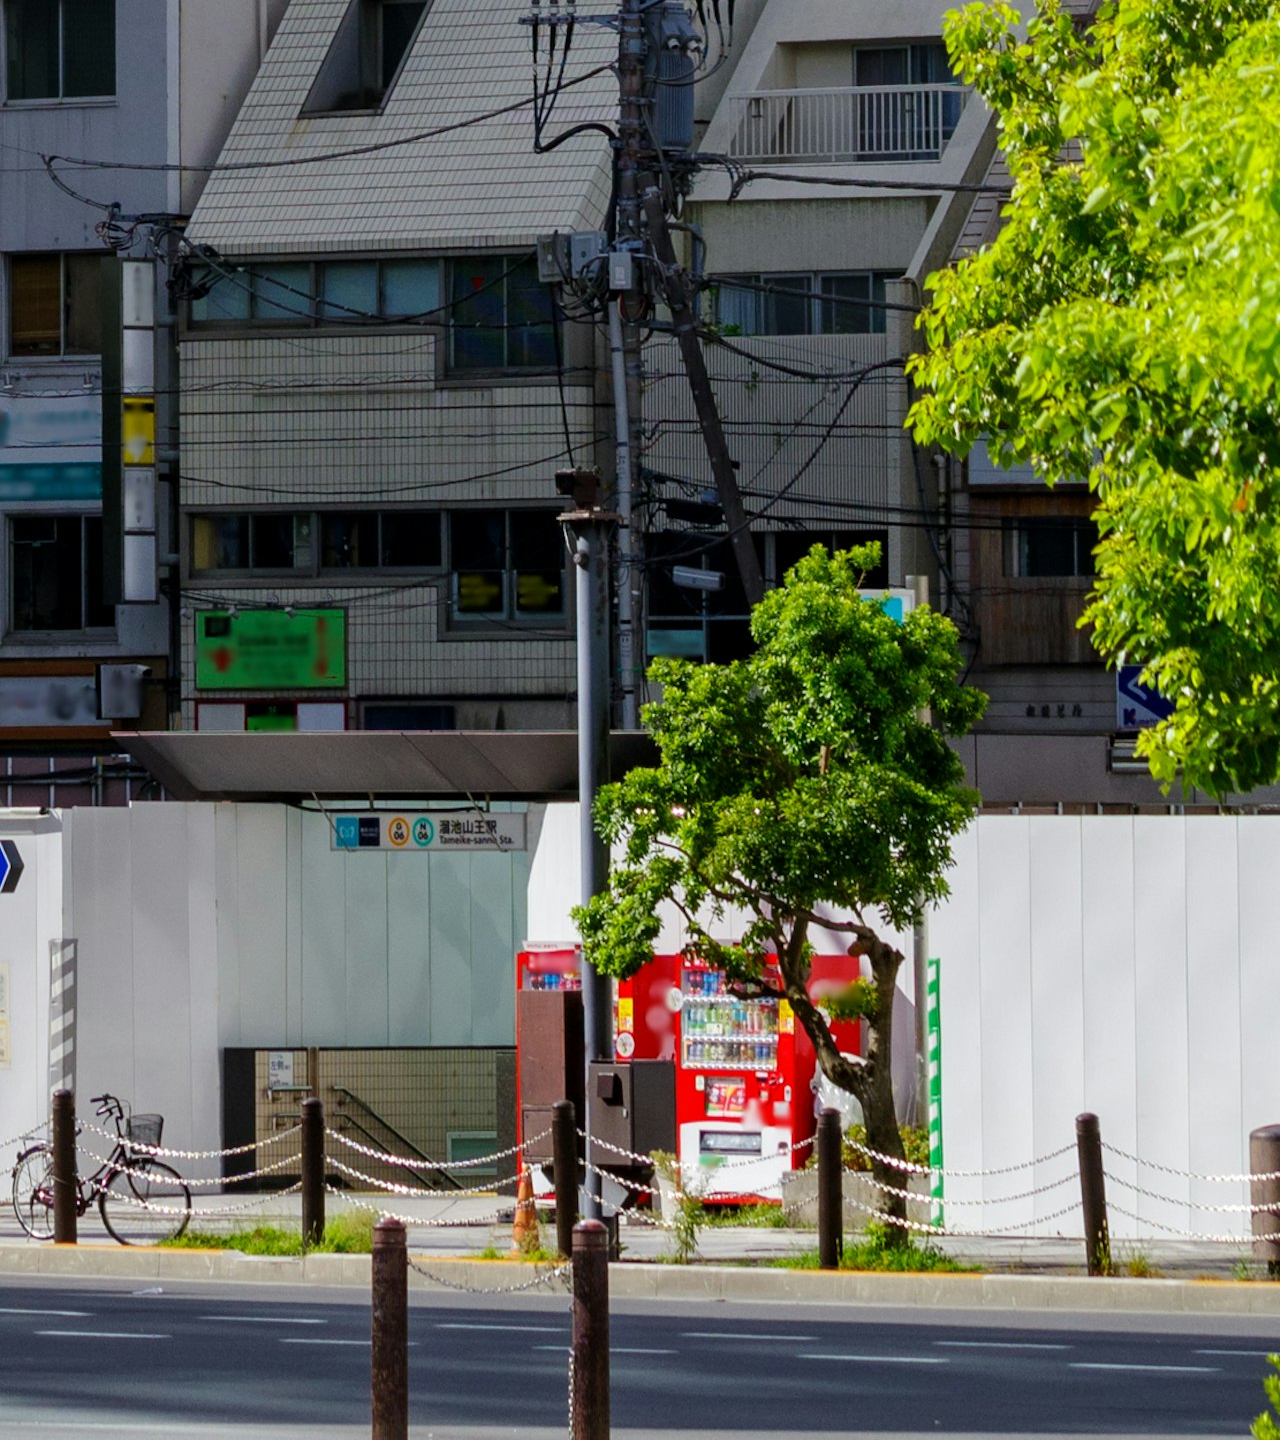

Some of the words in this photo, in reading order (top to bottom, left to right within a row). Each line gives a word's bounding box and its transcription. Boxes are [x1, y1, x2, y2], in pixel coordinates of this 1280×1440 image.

[439, 820, 497, 835] 溜池山王駅
[394, 831, 404, 840] 06
[418, 831, 428, 840] 06
[499, 836, 514, 844] Sta.
